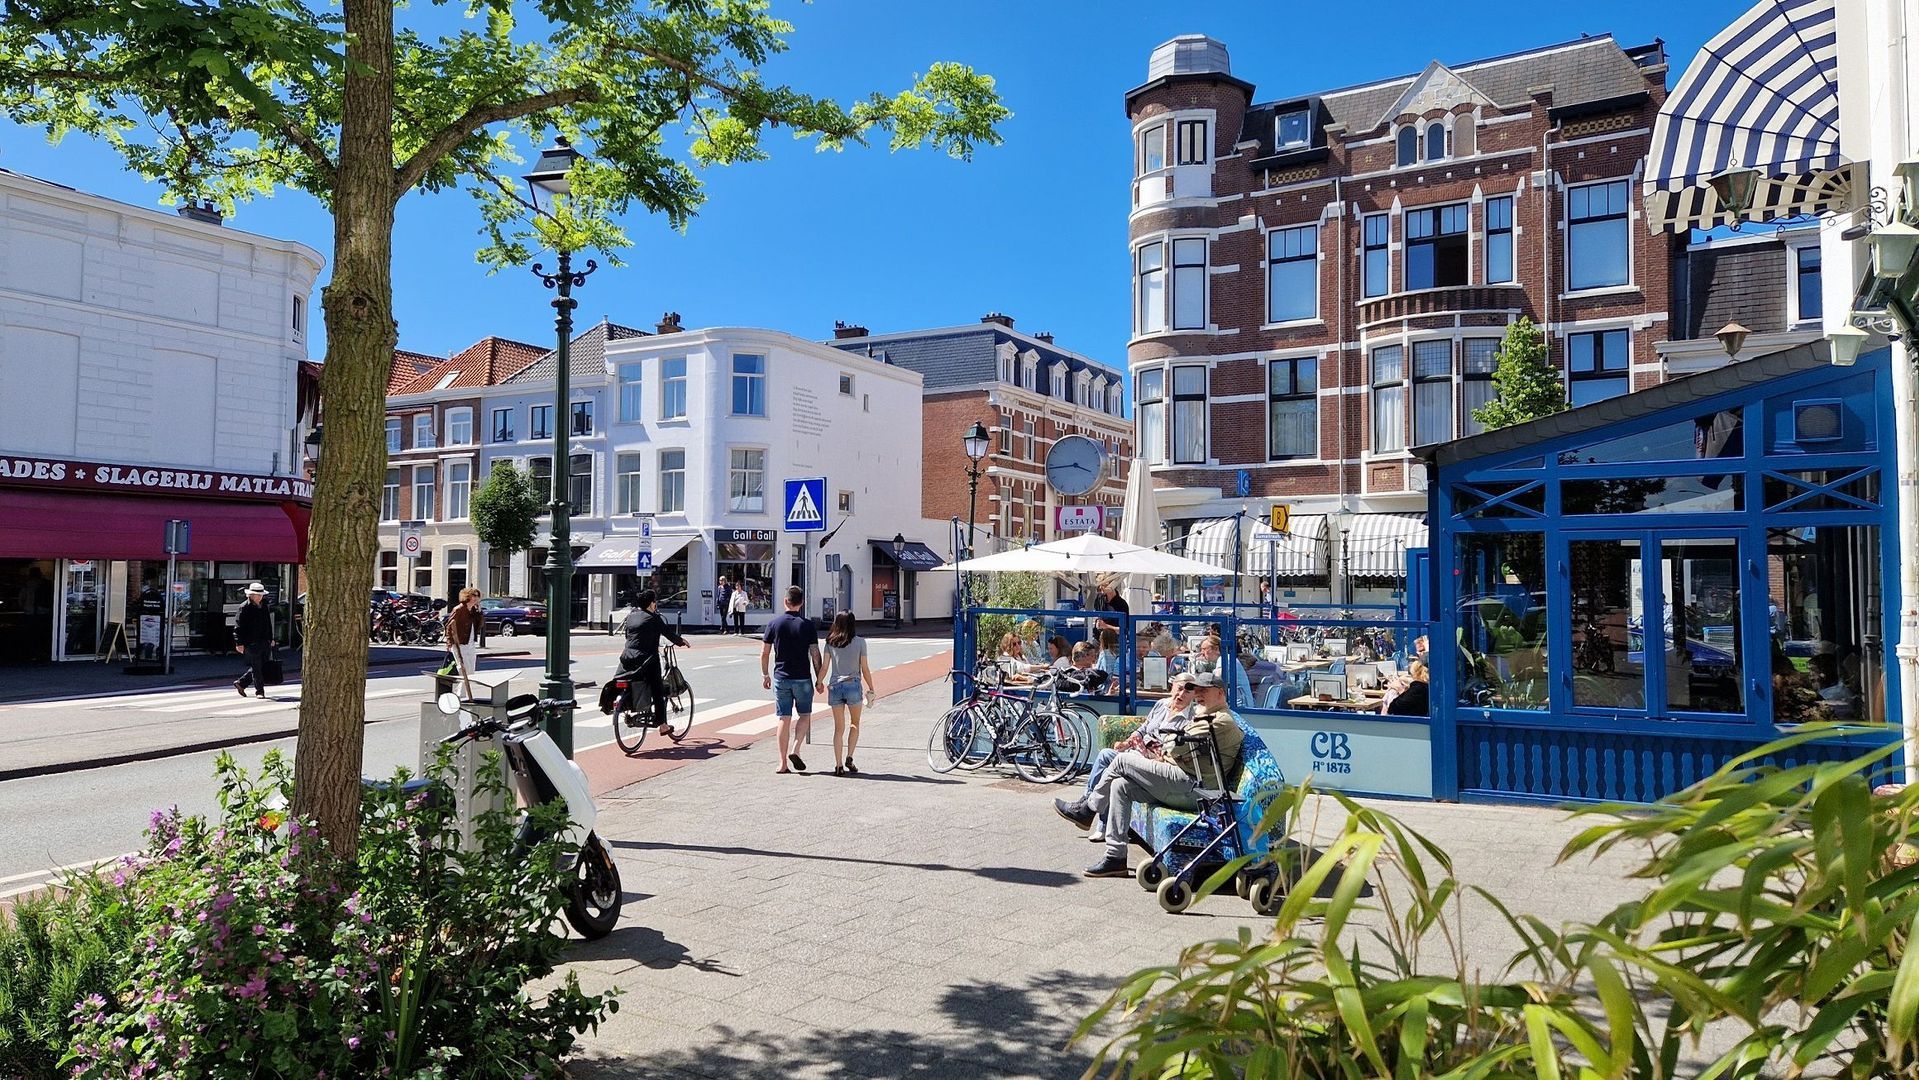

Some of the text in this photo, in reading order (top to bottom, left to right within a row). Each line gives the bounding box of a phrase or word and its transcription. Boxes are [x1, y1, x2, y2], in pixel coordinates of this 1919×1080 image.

[94, 466, 213, 490] SLAGERIJ
[219, 475, 291, 495] MATLA
[1064, 518, 1096, 526] ESTATA
[733, 530, 752, 540] Gall
[757, 530, 774, 540] Gall
[1310, 731, 1352, 760] CB
[1326, 762, 1351, 774] 1873
